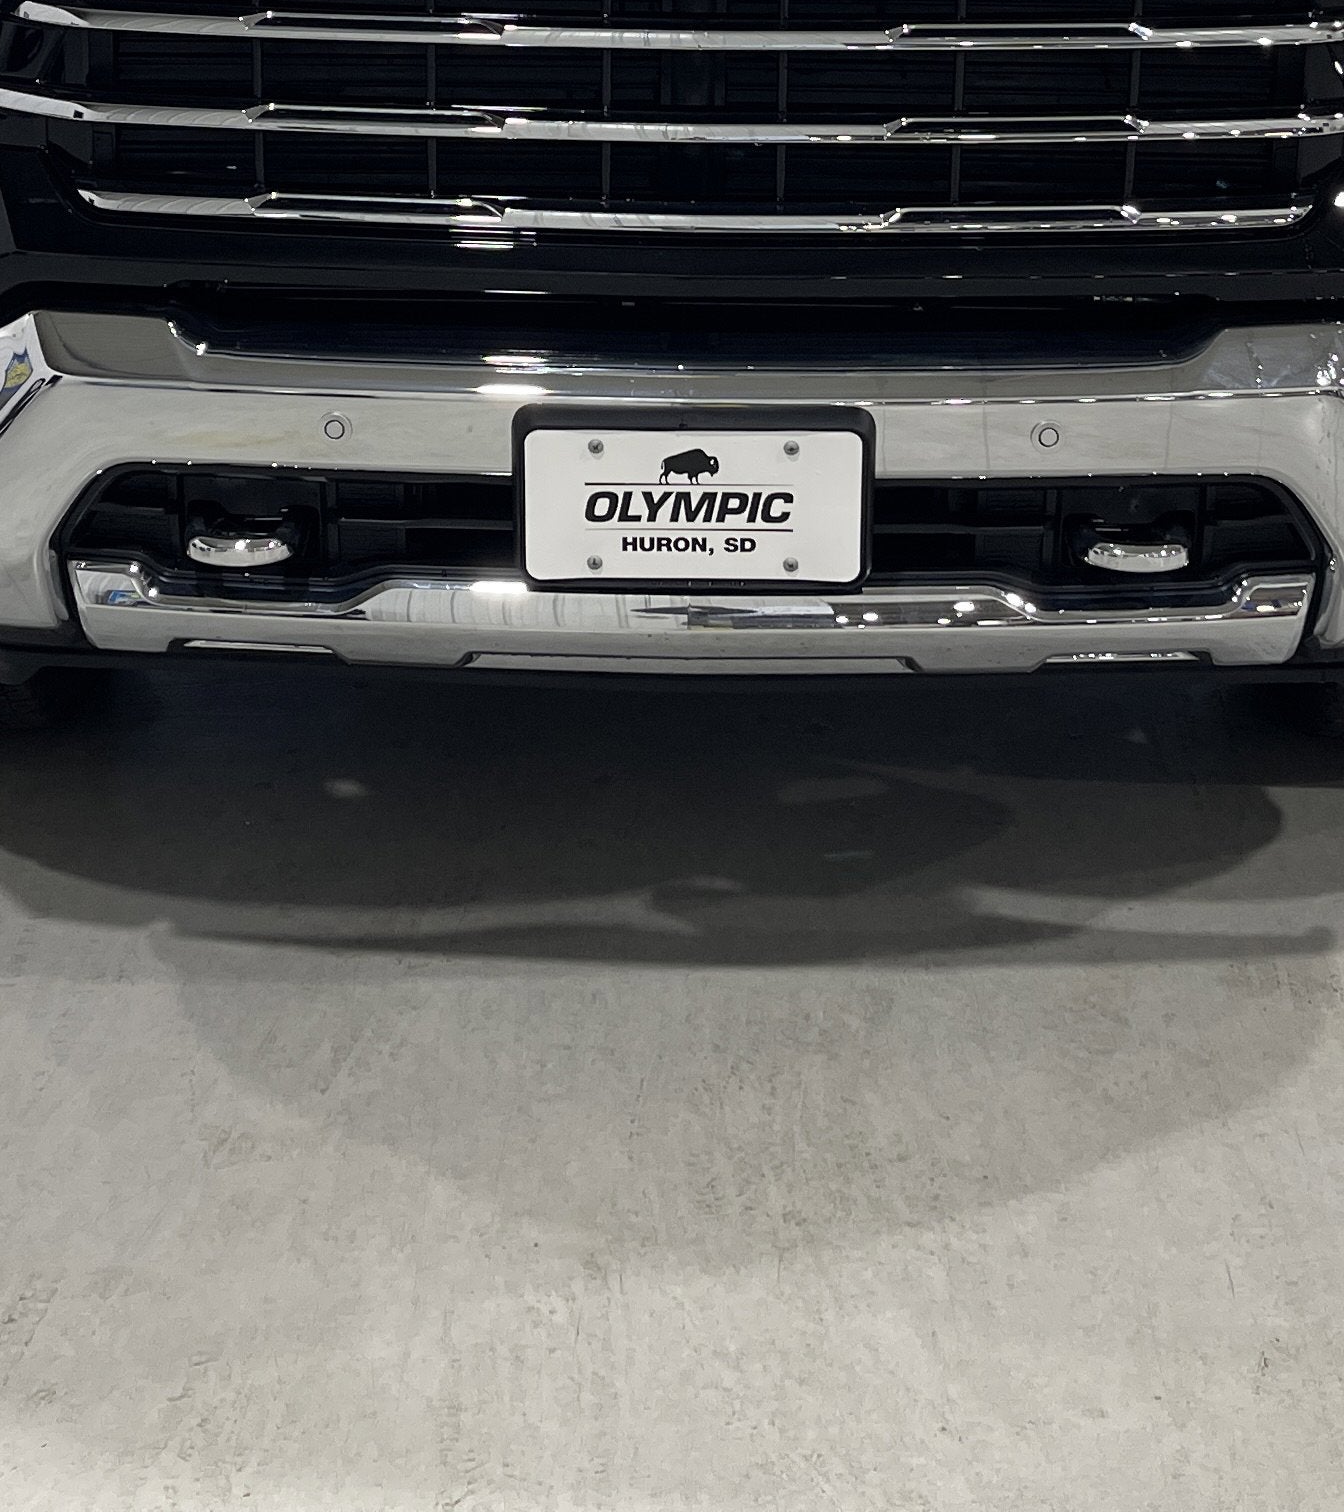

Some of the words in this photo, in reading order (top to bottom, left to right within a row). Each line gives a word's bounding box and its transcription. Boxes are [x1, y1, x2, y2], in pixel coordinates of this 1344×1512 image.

[584, 491, 794, 523] OLYMPIC
[622, 536, 715, 556] HURON,
[724, 537, 756, 553] SD
